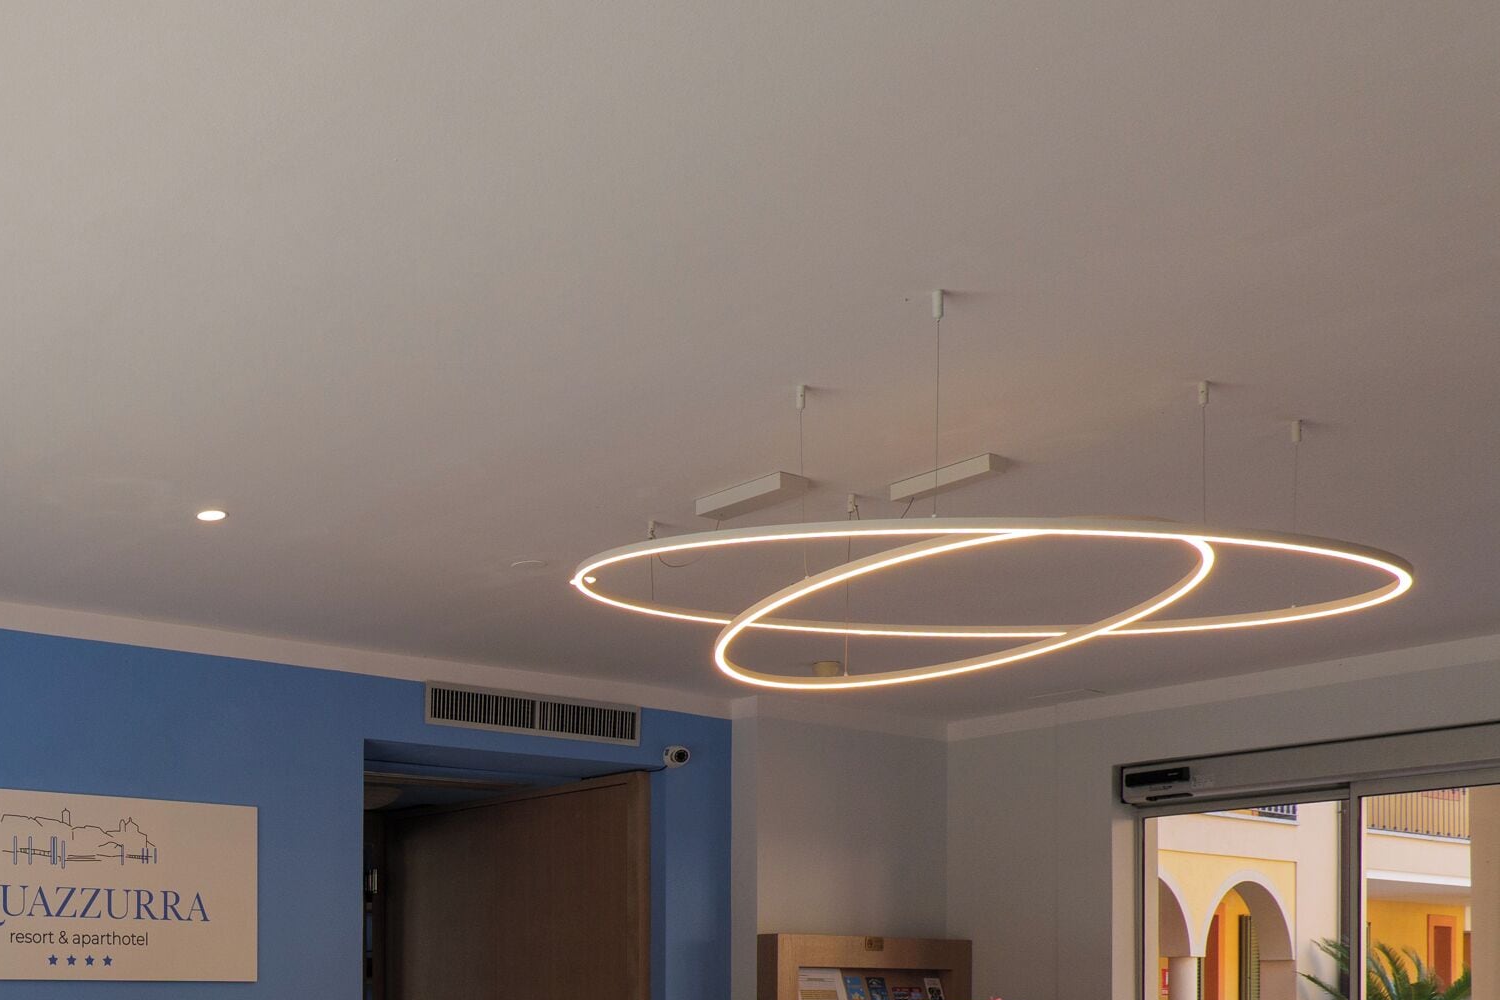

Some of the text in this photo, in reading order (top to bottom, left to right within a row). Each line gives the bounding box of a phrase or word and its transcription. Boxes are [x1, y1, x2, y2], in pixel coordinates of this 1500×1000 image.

[10, 930, 149, 948] resort & aparthotel
